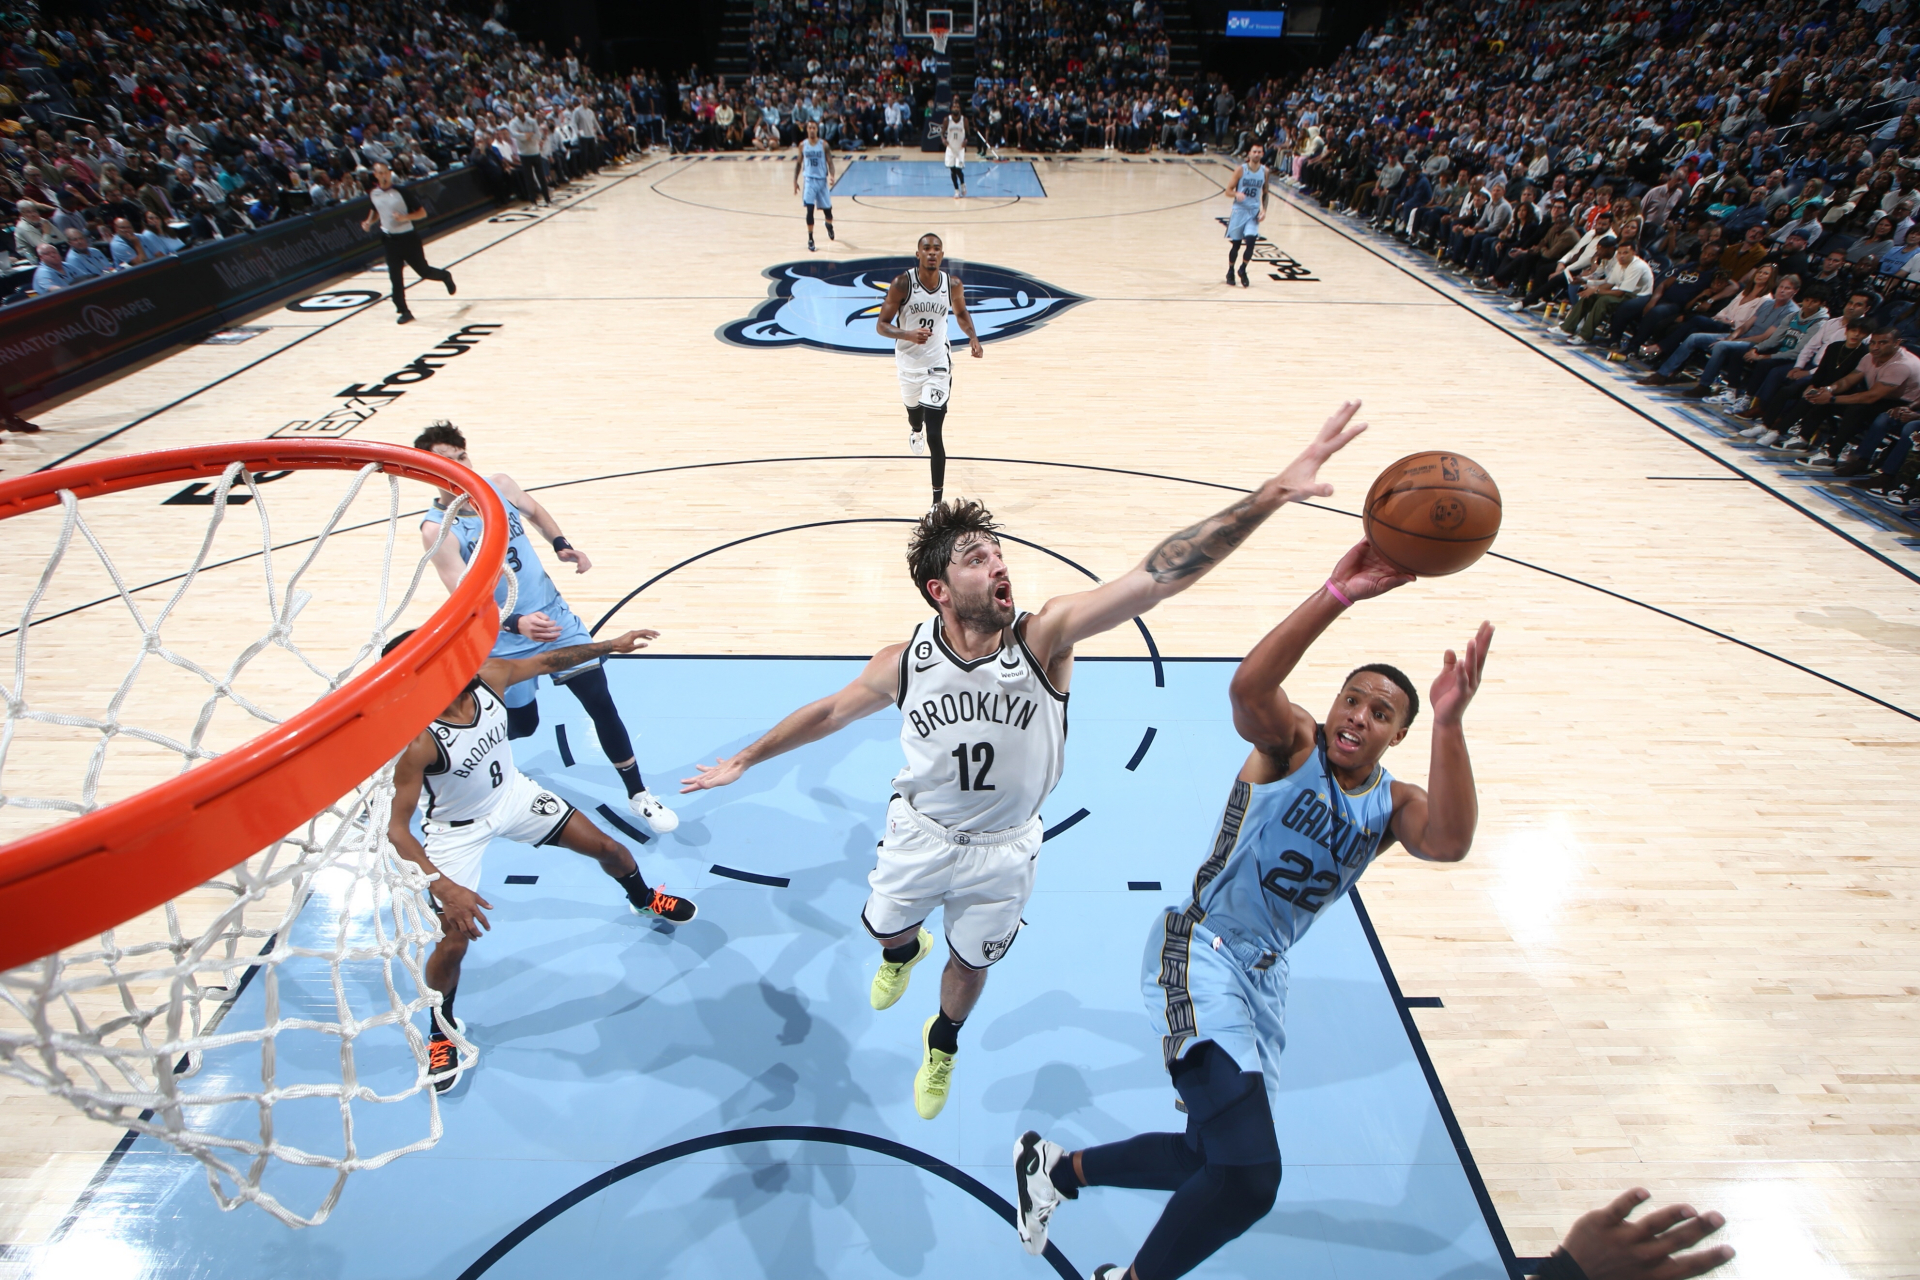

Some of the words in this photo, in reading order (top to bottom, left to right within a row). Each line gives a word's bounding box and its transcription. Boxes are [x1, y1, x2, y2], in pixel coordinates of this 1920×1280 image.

[212, 255, 275, 290] Making
[262, 240, 321, 271] Products
[310, 222, 354, 253] People
[909, 302, 947, 317] BROOKLYN
[0, 322, 91, 366] RNATIONAL
[112, 297, 156, 321] PAPER
[160, 324, 503, 505] FExForum
[507, 546, 523, 573] 3
[918, 643, 929, 657] 6
[1001, 669, 1024, 679] Webull
[438, 728, 449, 739] 6
[909, 691, 1038, 738] BROOKLYN
[453, 720, 508, 778] BROOKLY
[951, 742, 996, 791] 12
[489, 760, 503, 789] 8
[532, 793, 552, 815] NETS
[1262, 849, 1340, 913] 22
